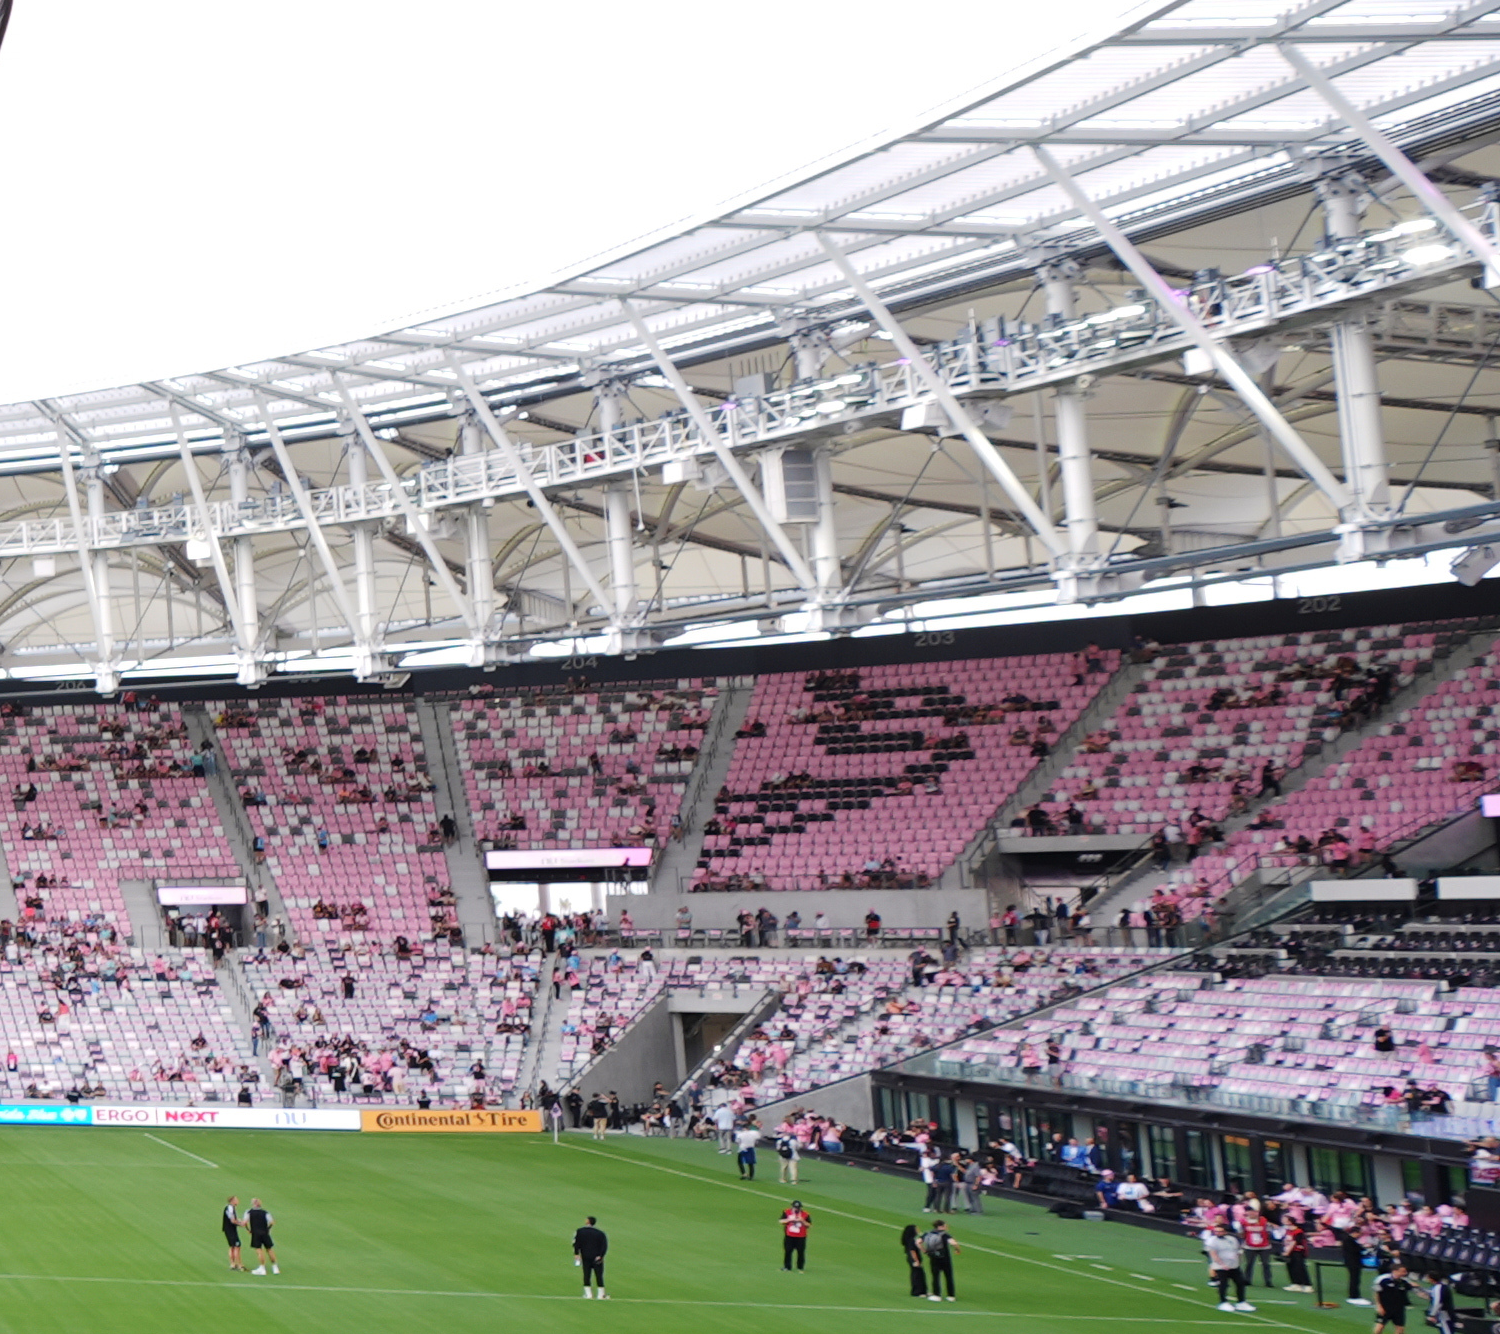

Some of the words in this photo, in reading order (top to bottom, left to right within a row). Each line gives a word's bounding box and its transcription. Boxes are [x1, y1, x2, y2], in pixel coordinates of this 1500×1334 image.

[1297, 595, 1342, 614] 202
[914, 630, 956, 647] 203
[561, 655, 599, 670] 204
[96, 1109, 150, 1122] ERGO
[376, 1112, 471, 1130] Continental
[486, 1113, 528, 1126] Tire
